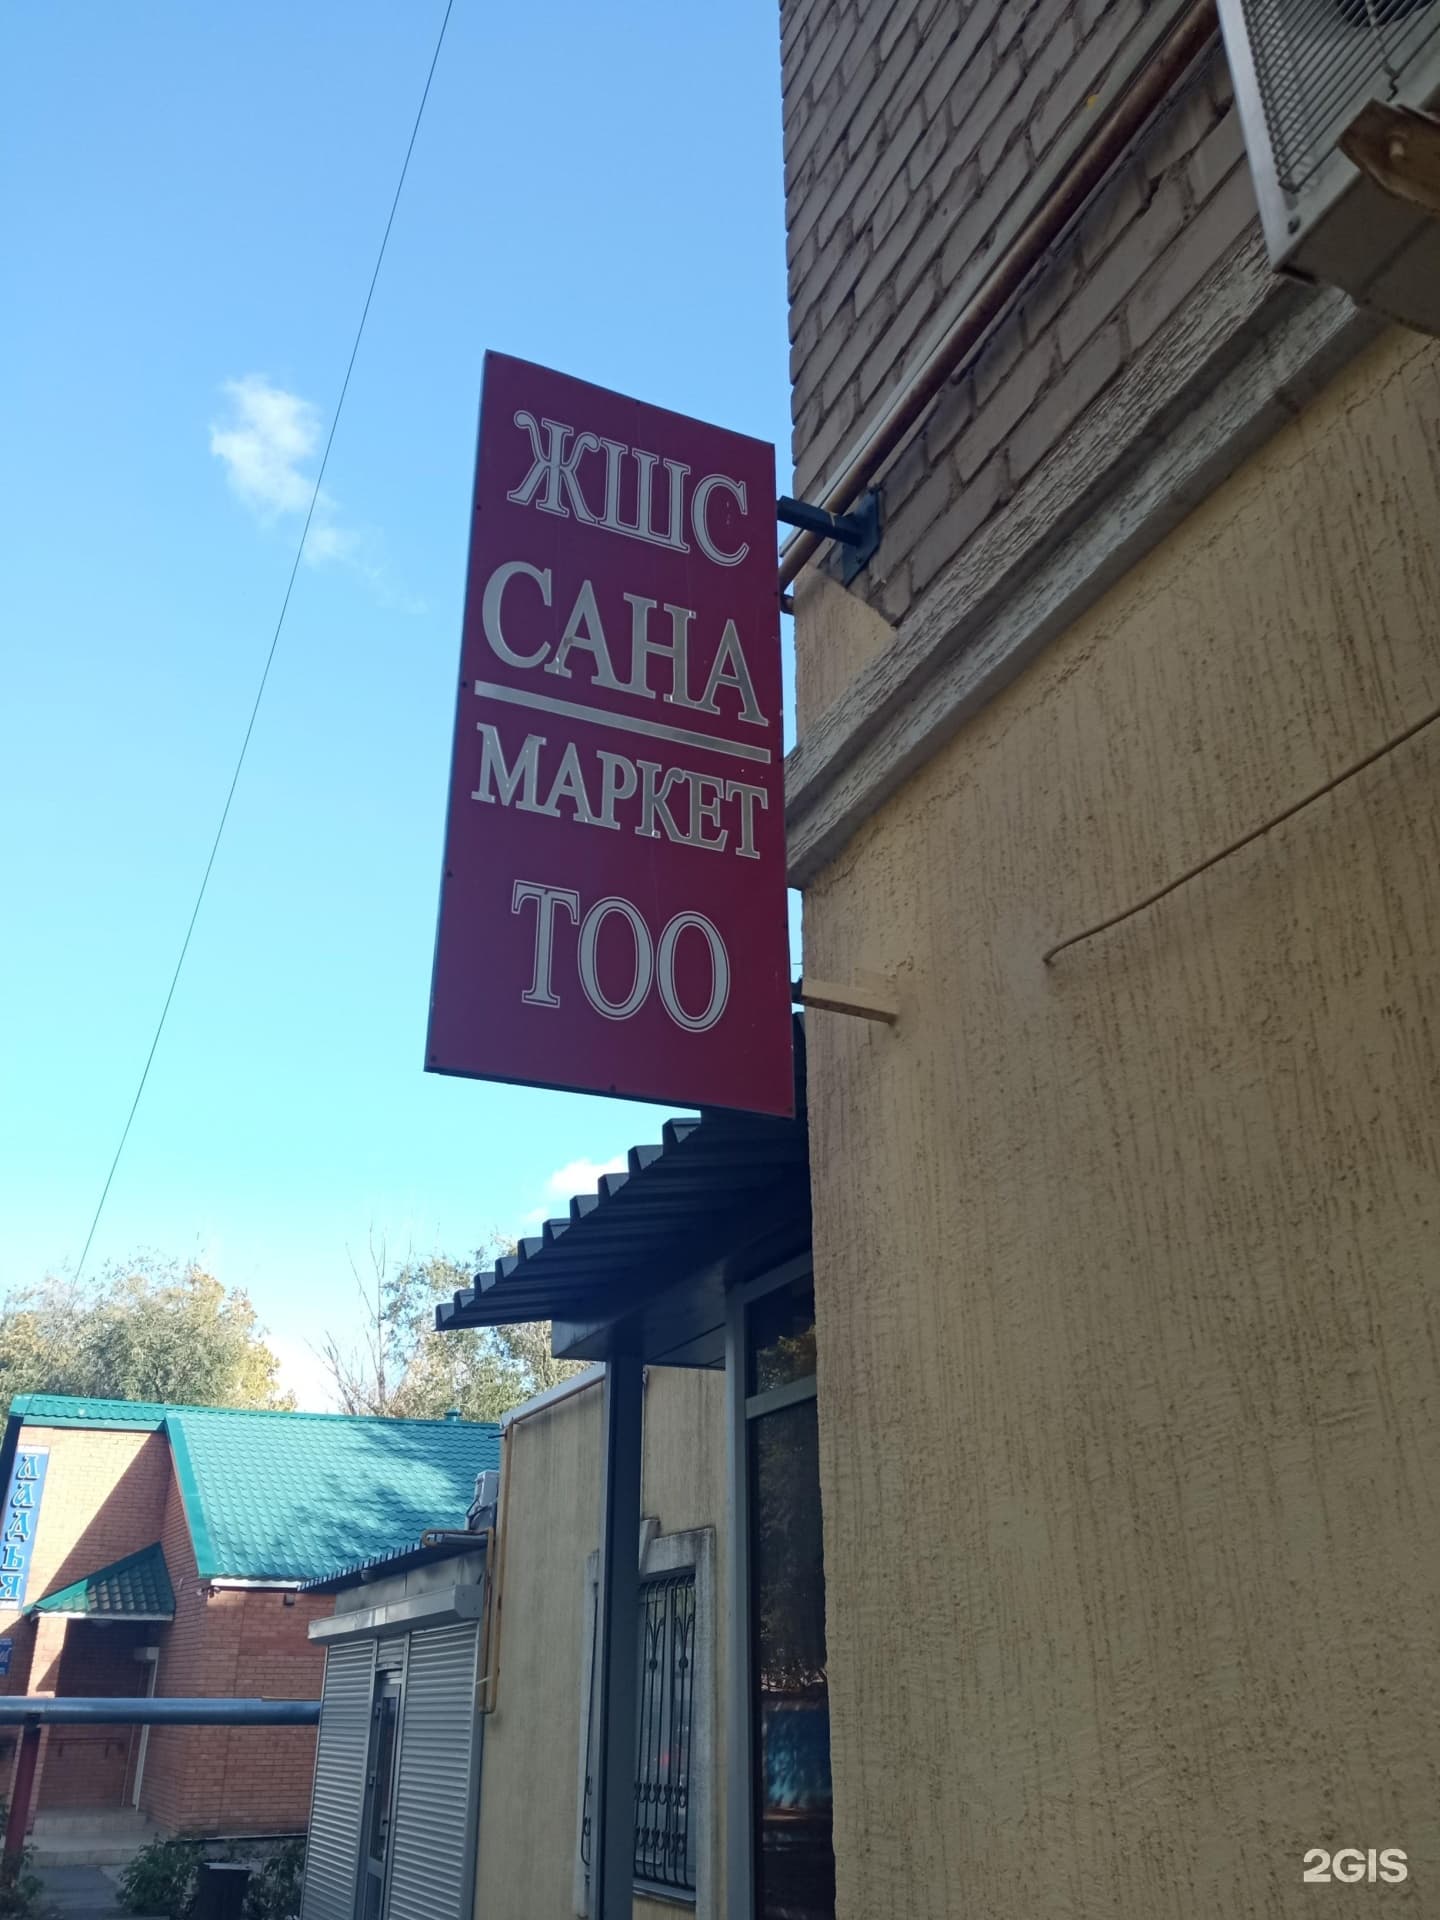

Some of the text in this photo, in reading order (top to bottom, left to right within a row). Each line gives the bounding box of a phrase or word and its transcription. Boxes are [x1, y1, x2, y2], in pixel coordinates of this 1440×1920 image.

[507, 409, 750, 567] ЖШС
[482, 560, 769, 727] САНА
[471, 721, 769, 860] МАРКЕТ
[511, 879, 731, 1033] ТОО
